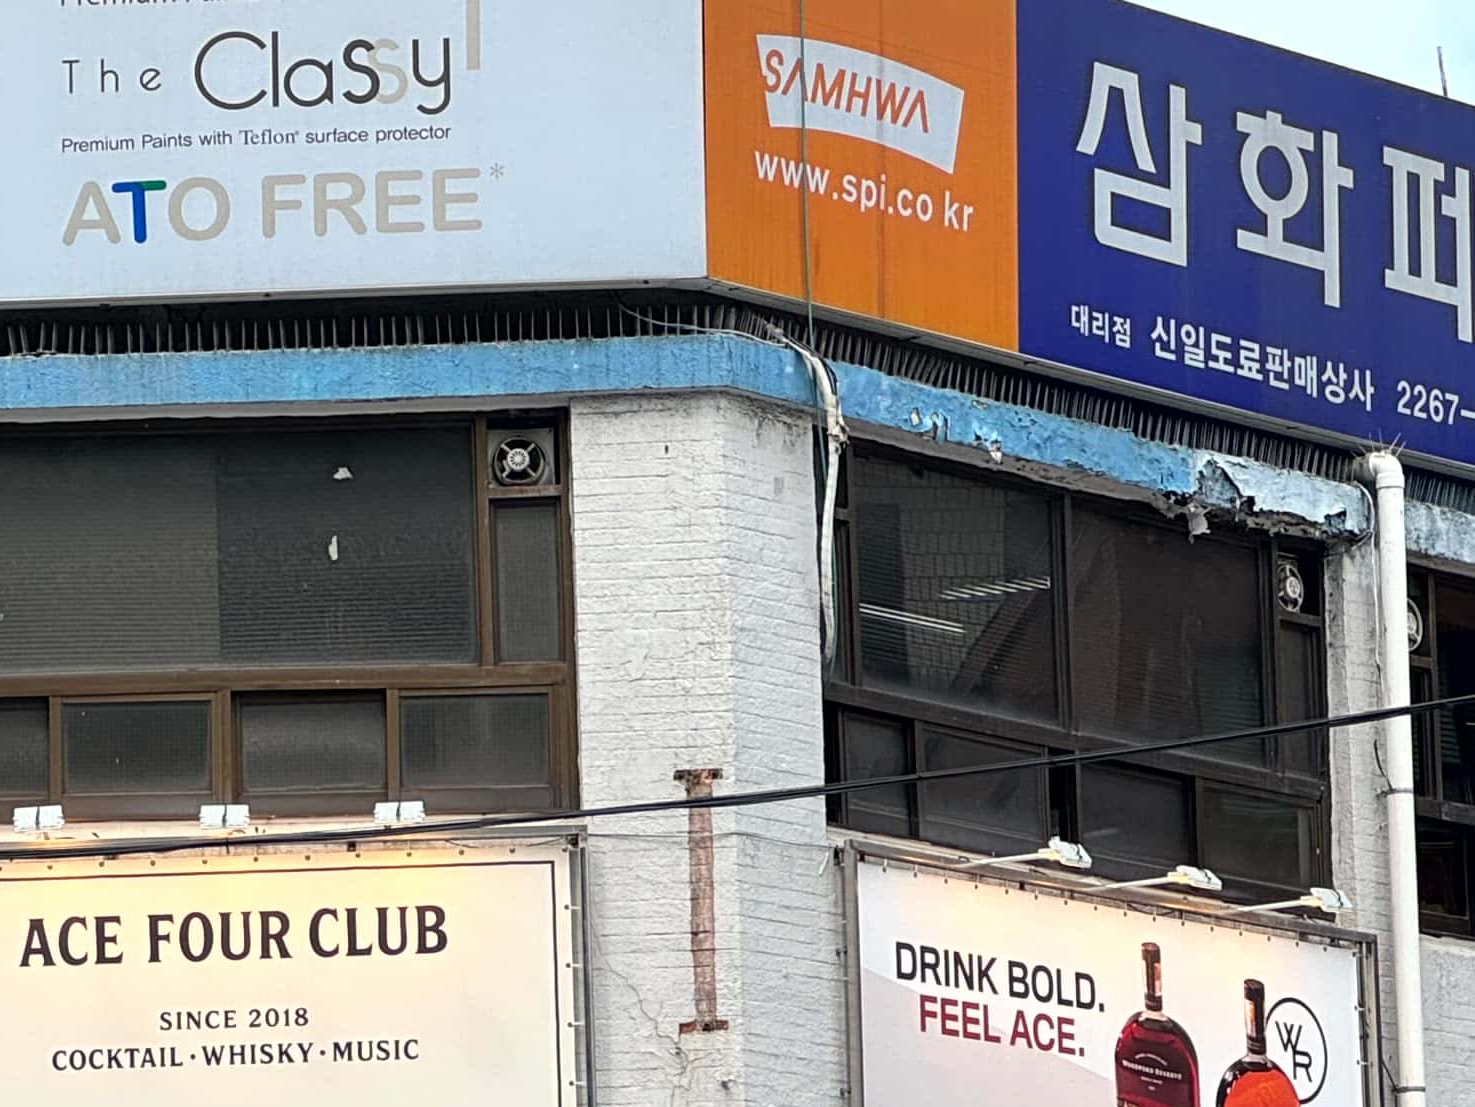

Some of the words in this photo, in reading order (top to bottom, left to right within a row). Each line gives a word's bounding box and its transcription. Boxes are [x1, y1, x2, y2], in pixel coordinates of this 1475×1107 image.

[62, 59, 163, 94] The
[194, 30, 452, 116] Classy
[61, 137, 135, 154] Premium
[141, 133, 193, 150] Paints
[198, 130, 233, 146] with
[305, 128, 370, 144] surface
[375, 125, 452, 146] protector
[61, 176, 232, 248] ATO
[1071, 305, 1131, 348] 대리점
[1149, 316, 1375, 412] 신일도료판매상사
[18, 914, 124, 968] ACE
[146, 908, 292, 964] FOUR
[308, 902, 450, 960] CLUB
[895, 941, 999, 996] DRINK
[1008, 958, 1106, 1013] BOLD.
[158, 1010, 236, 1032] SINCE
[248, 1006, 310, 1030] 2018
[919, 993, 1002, 1044] FEEL
[1009, 1009, 1087, 1057] ACE.
